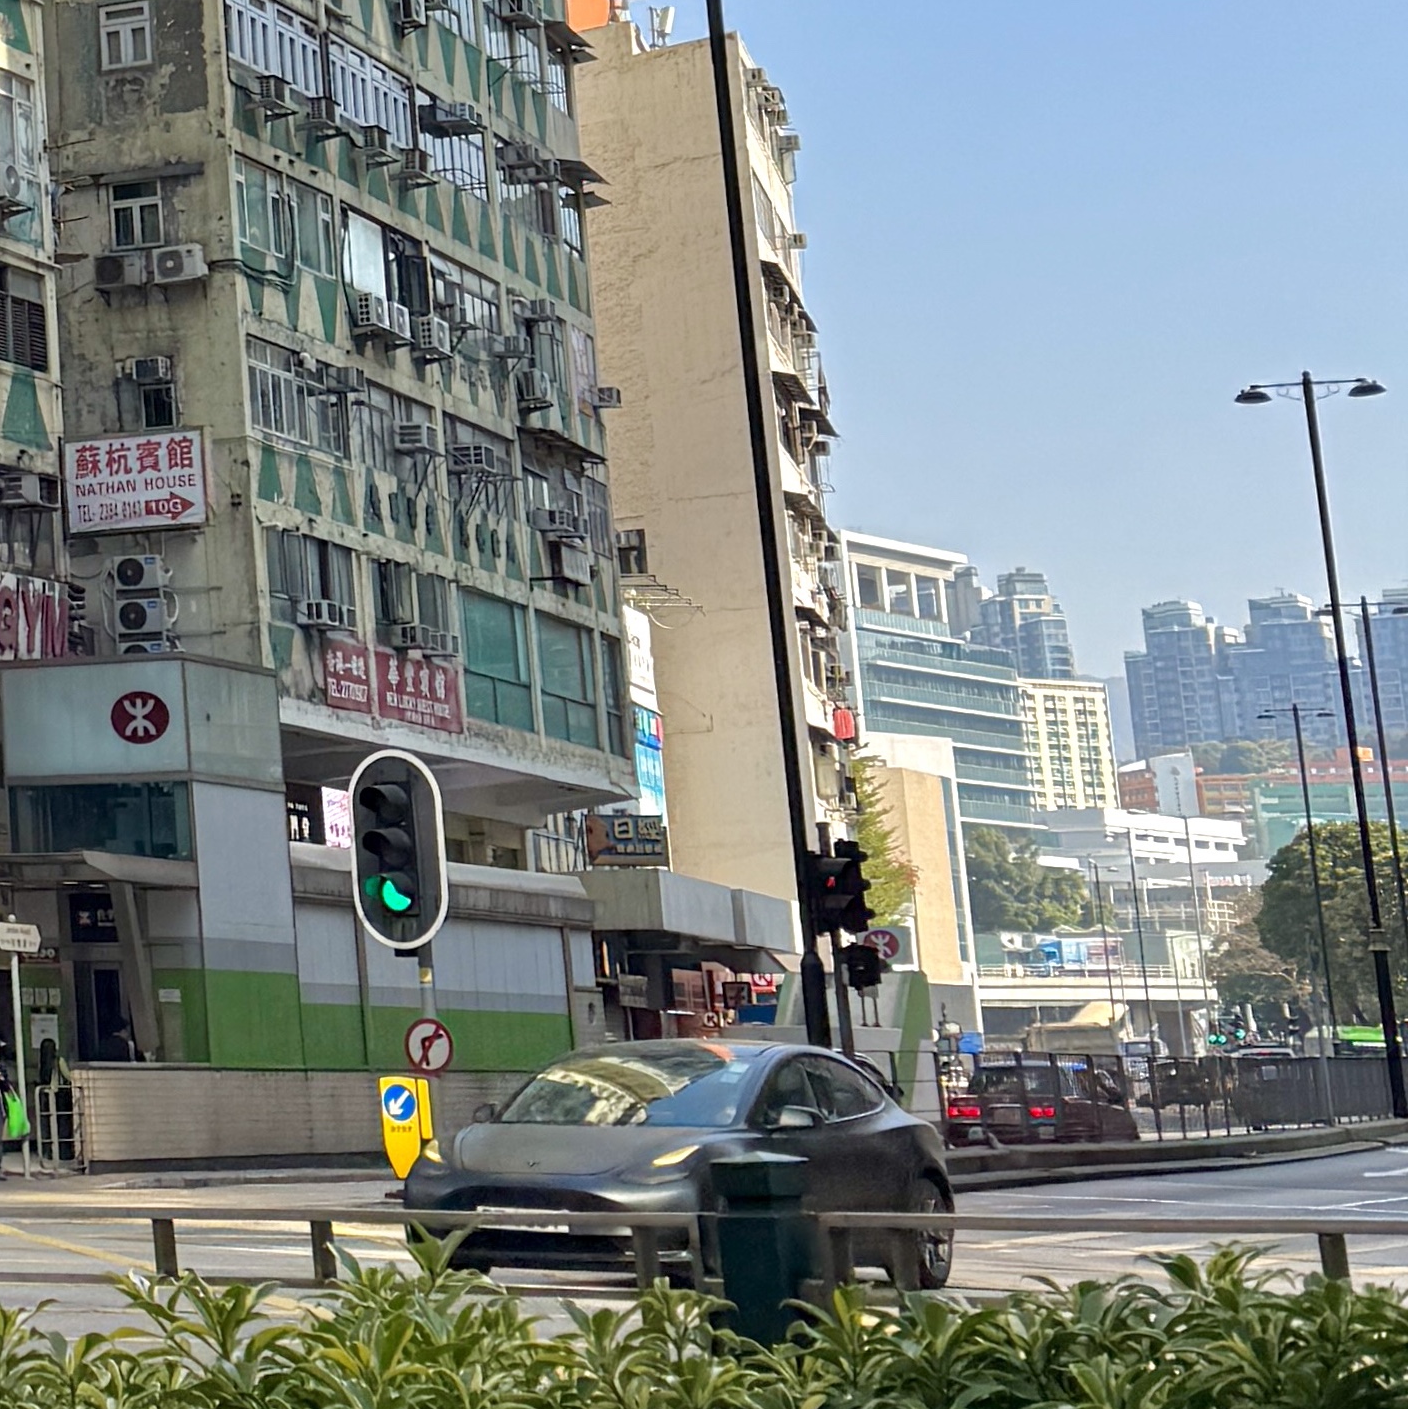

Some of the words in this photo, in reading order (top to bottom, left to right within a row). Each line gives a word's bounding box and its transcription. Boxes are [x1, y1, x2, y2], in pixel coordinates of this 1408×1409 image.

[75, 435, 194, 480] 蘇杭賓館
[76, 479, 137, 498] NATHAN
[144, 473, 197, 491] HOUSE
[150, 498, 183, 514] 10G
